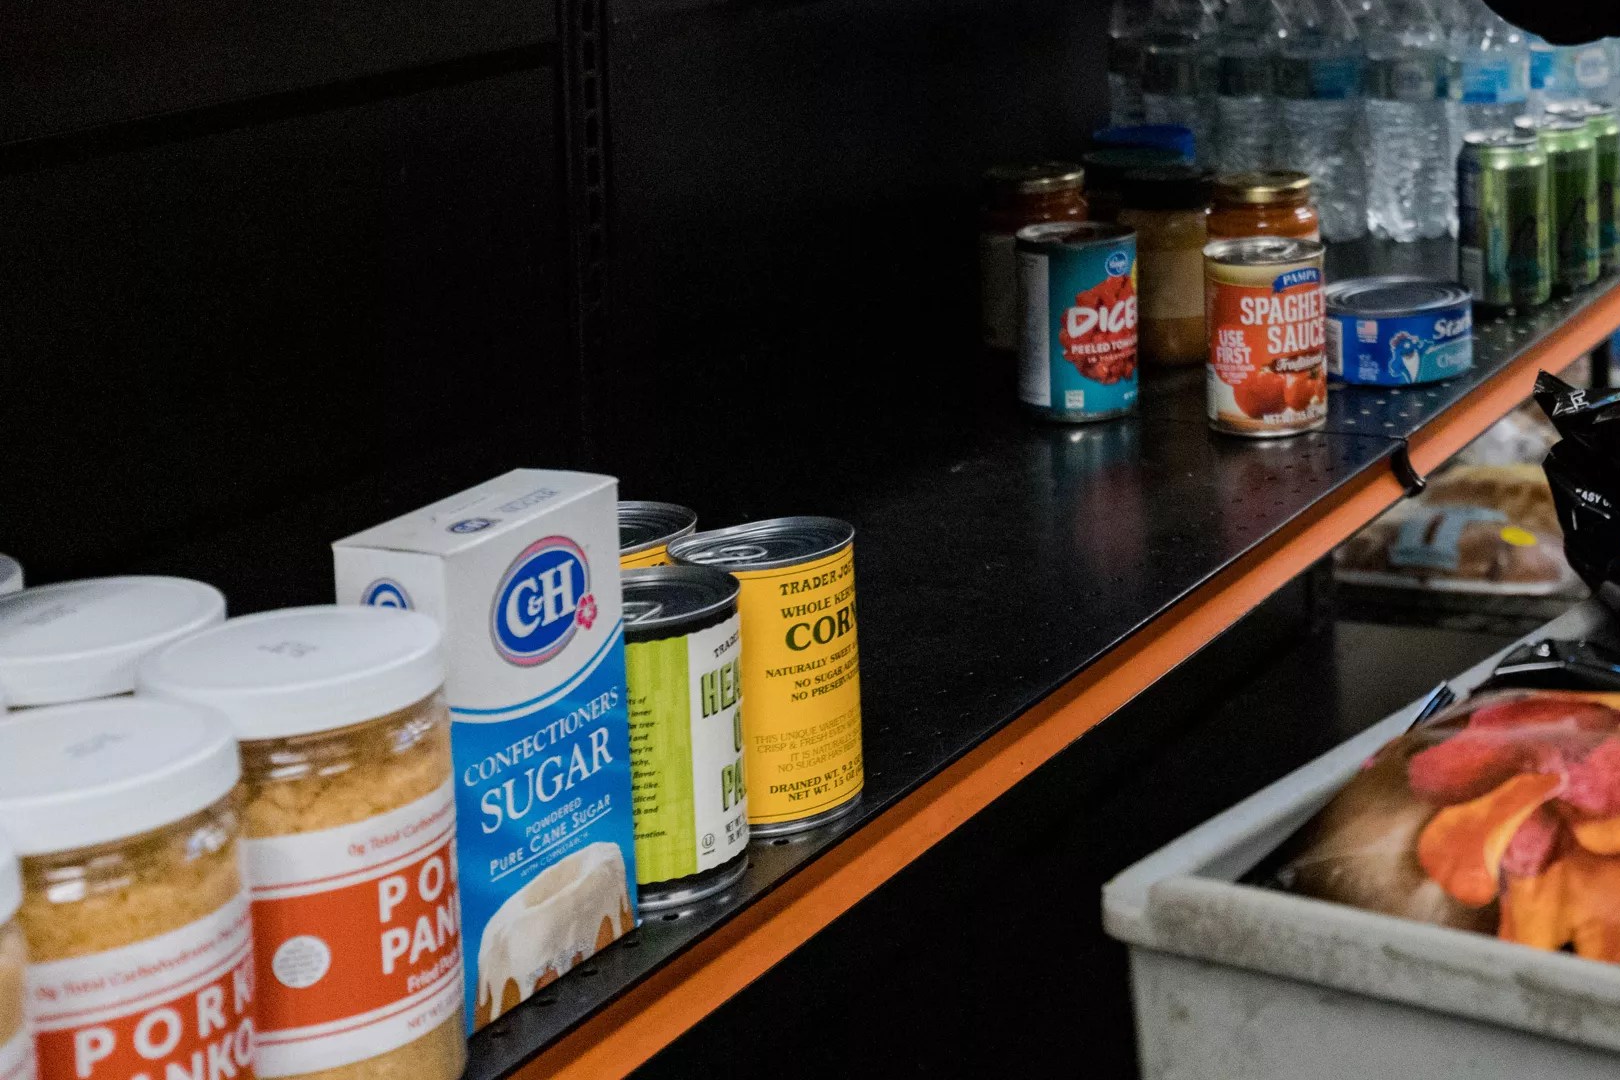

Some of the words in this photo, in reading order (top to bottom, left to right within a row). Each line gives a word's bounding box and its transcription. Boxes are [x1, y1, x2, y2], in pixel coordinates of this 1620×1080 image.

[1217, 329, 1246, 348] USE
[1266, 316, 1326, 355] SAUCE
[1071, 341, 1111, 355] PEELED
[1216, 347, 1252, 365] FIRST
[779, 569, 837, 597] TRADER
[505, 558, 578, 639] C&H
[779, 596, 832, 620] WHOLE
[765, 655, 829, 680] NATURALLY
[829, 645, 852, 664] SWEET
[794, 678, 812, 690] NO
[814, 666, 844, 686] SUGAR
[791, 691, 809, 703] NO
[463, 685, 619, 788] CONFECTIONERS
[633, 733, 649, 743] and
[753, 733, 779, 746] THIS
[780, 725, 818, 742] UNIQUE
[757, 740, 788, 755] CRISP
[800, 732, 826, 747] FRESH
[778, 762, 795, 774] NO
[795, 753, 827, 770] SUGAR
[480, 726, 614, 835] SUGAR
[769, 775, 822, 795] DRAINED
[823, 768, 841, 781] WT.
[841, 760, 854, 773] 9.2
[788, 788, 811, 803] NET
[812, 782, 832, 796] WT.
[832, 776, 845, 790] 15
[845, 768, 856, 782] OZ
[525, 796, 583, 838] POWDERED
[643, 806, 659, 816] and
[489, 847, 524, 877] PURE
[529, 821, 568, 854] CANE
[571, 793, 612, 829] SUGAR
